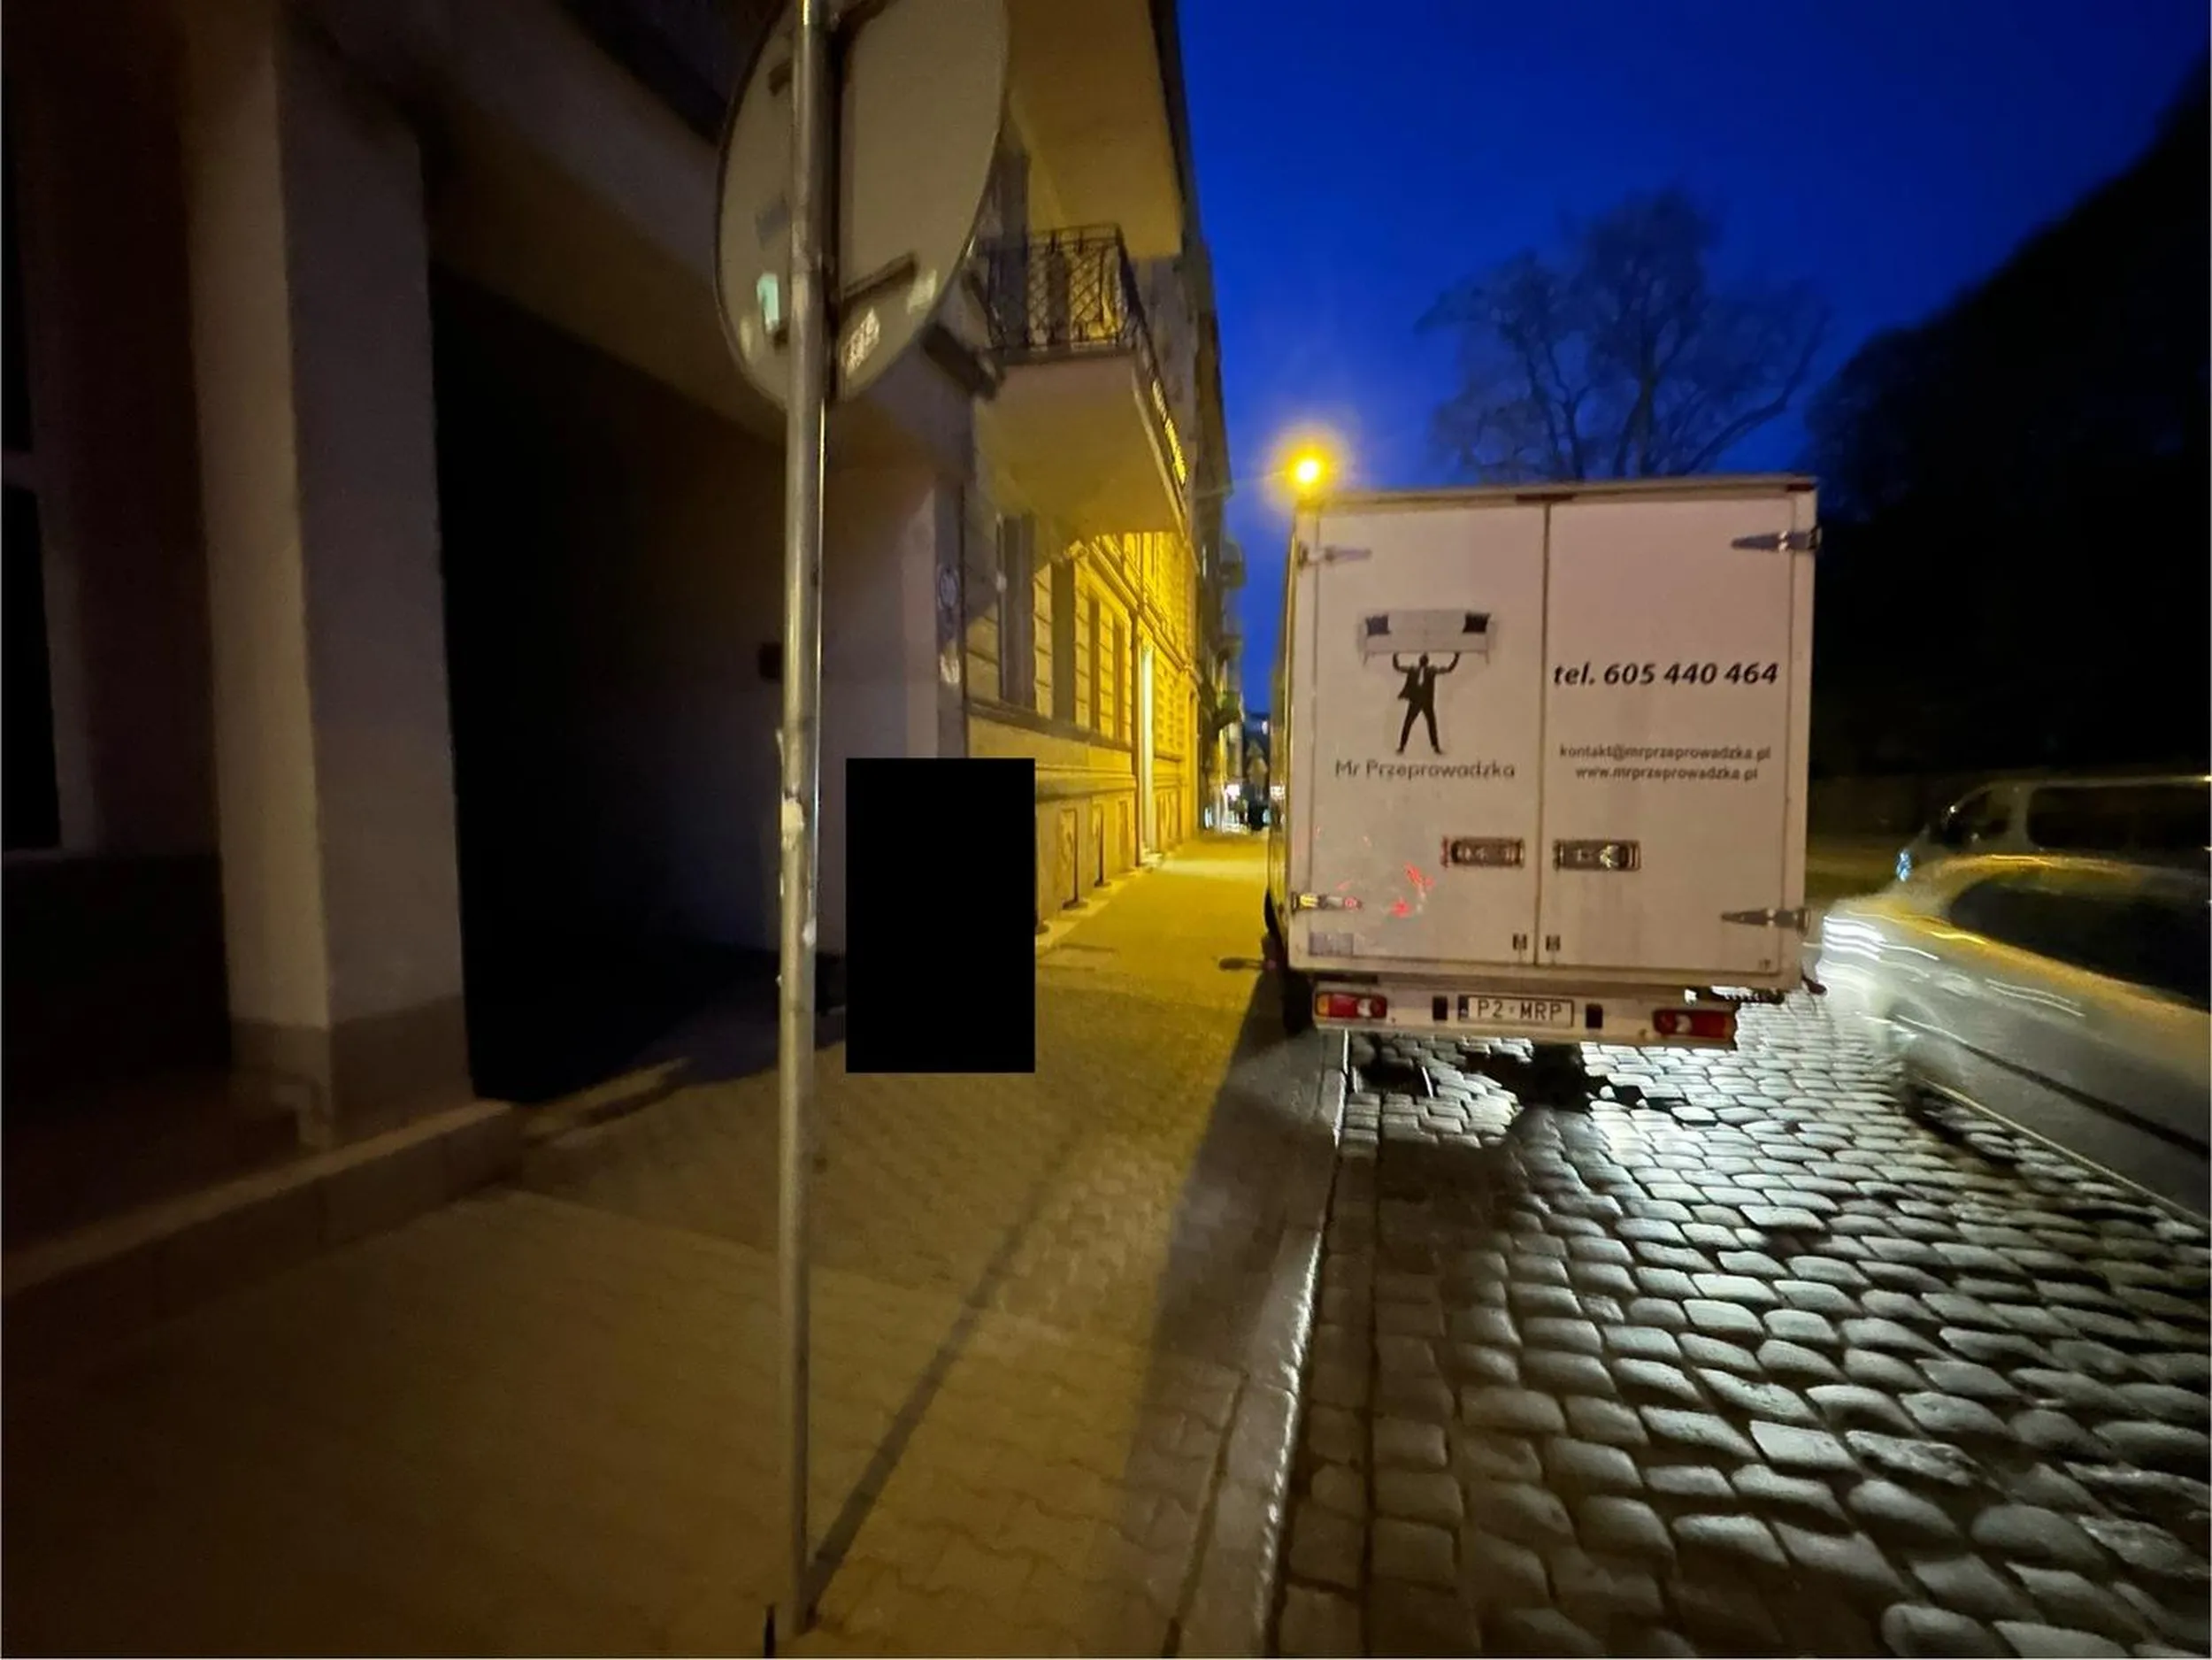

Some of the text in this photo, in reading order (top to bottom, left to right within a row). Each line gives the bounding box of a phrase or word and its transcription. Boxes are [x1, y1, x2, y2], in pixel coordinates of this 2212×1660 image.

[1554, 662, 1778, 685] tel. 605 440 464
[1560, 743, 1771, 762] kontakt@mrprzeprowadzkapl
[1335, 759, 1515, 780] Mr Przeprowadzka
[1576, 765, 1758, 780] www.mrprzeprowadzkapl
[1478, 999, 1562, 1020] P2 MRP
